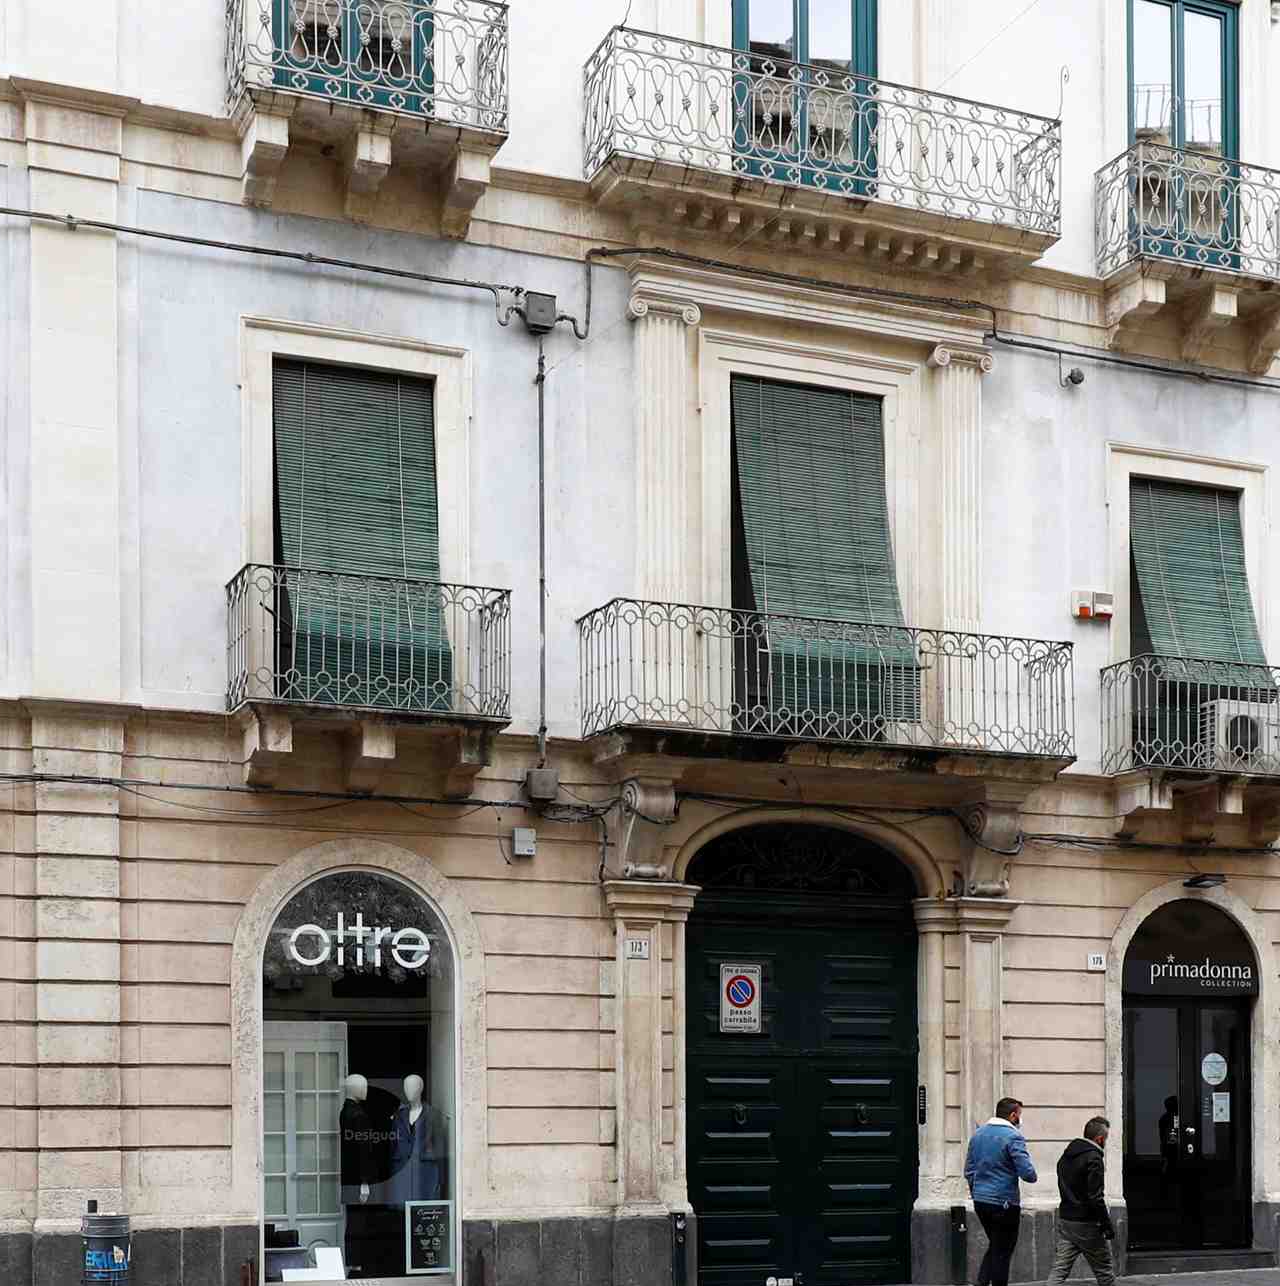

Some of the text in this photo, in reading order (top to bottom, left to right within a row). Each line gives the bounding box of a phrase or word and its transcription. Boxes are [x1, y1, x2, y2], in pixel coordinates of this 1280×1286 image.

[289, 911, 431, 969] oltre
[1150, 954, 1252, 985] primadonna
[1200, 979, 1252, 988] COLLECTION
[344, 1128, 400, 1144] Desigual
